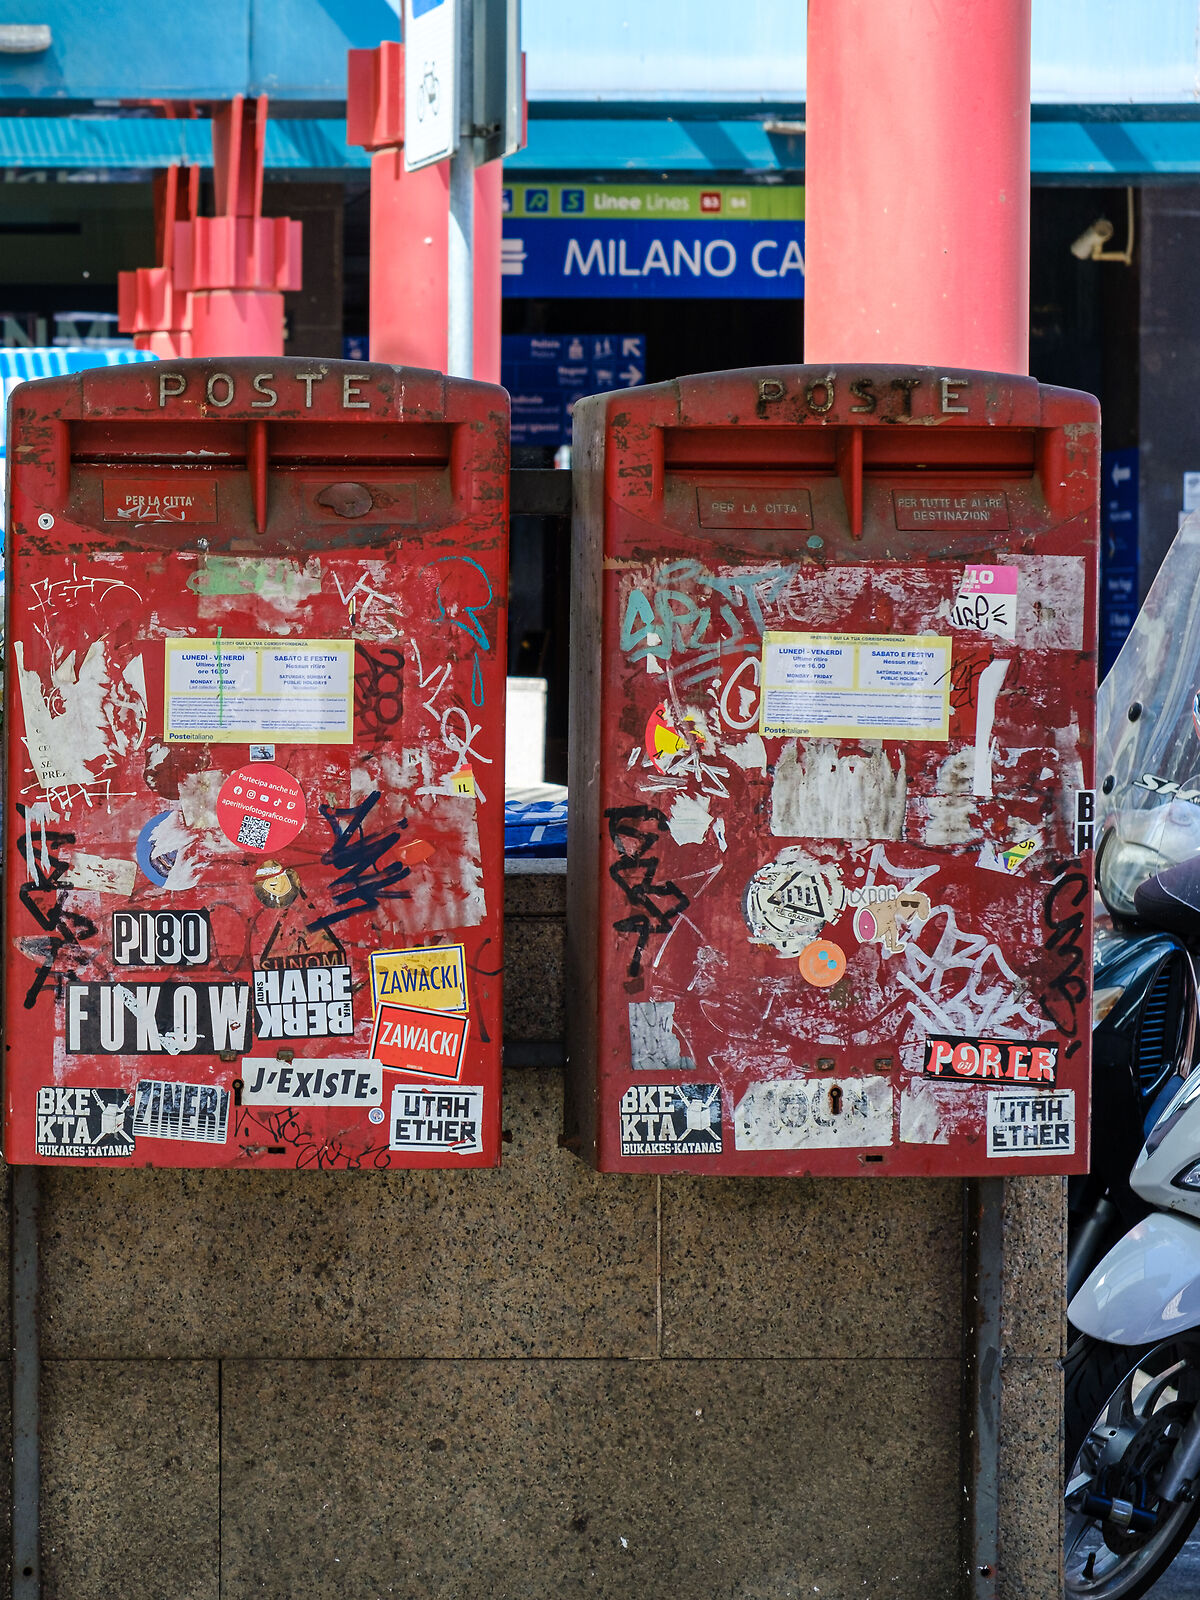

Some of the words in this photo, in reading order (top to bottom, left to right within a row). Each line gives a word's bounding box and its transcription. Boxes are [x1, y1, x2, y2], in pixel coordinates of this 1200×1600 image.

[593, 193, 641, 211] Linee
[646, 193, 690, 211] Lines
[563, 238, 737, 277] MILANO
[158, 373, 371, 409] POSTE
[757, 376, 969, 414] POSTE
[125, 495, 145, 506] PER
[148, 495, 160, 506] LA
[711, 502, 734, 513] PER
[743, 503, 757, 513] LA
[898, 498, 918, 509] PER
[238, 772, 268, 788] Partecipa
[268, 782, 289, 794] anche
[221, 798, 298, 826] aperitivofotografico.com
[254, 967, 352, 1005] HARE
[379, 964, 458, 995] ZAWACKI
[378, 1021, 459, 1057] ZAWACKI
[250, 1067, 378, 1099] J'EXISTE.
[38, 1087, 91, 1116] BKE
[404, 1095, 470, 1118] UTAH
[622, 1086, 675, 1113] BKE
[999, 1100, 1063, 1123] UTAH
[38, 1116, 92, 1144] KTA
[395, 1119, 476, 1143] ETHER
[621, 1114, 677, 1142] KTA
[993, 1123, 1070, 1147] ETHER
